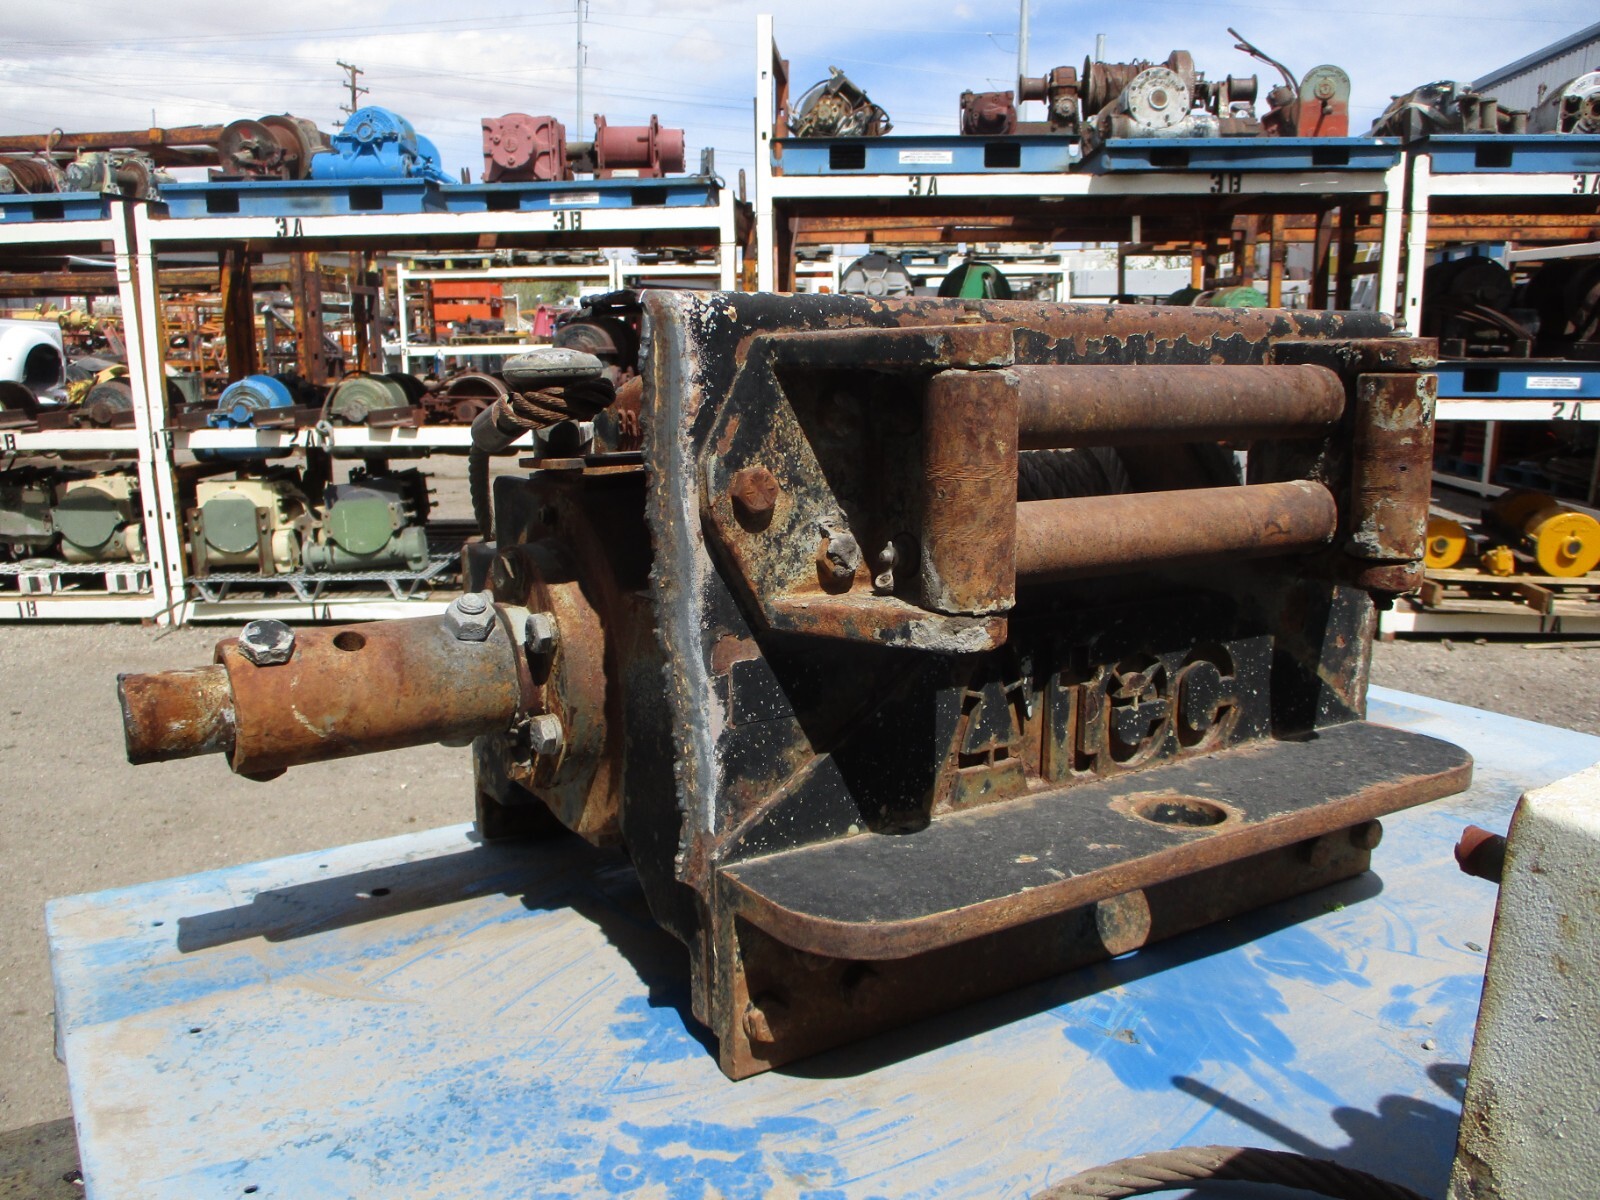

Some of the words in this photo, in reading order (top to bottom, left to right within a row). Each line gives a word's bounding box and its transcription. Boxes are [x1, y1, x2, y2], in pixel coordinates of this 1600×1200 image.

[908, 175, 938, 196] 3A
[1210, 173, 1242, 193] 3B
[275, 217, 304, 237] 3A
[553, 210, 582, 231] 3B
[1552, 401, 1582, 421] 2A
[17, 601, 38, 618] 1B
